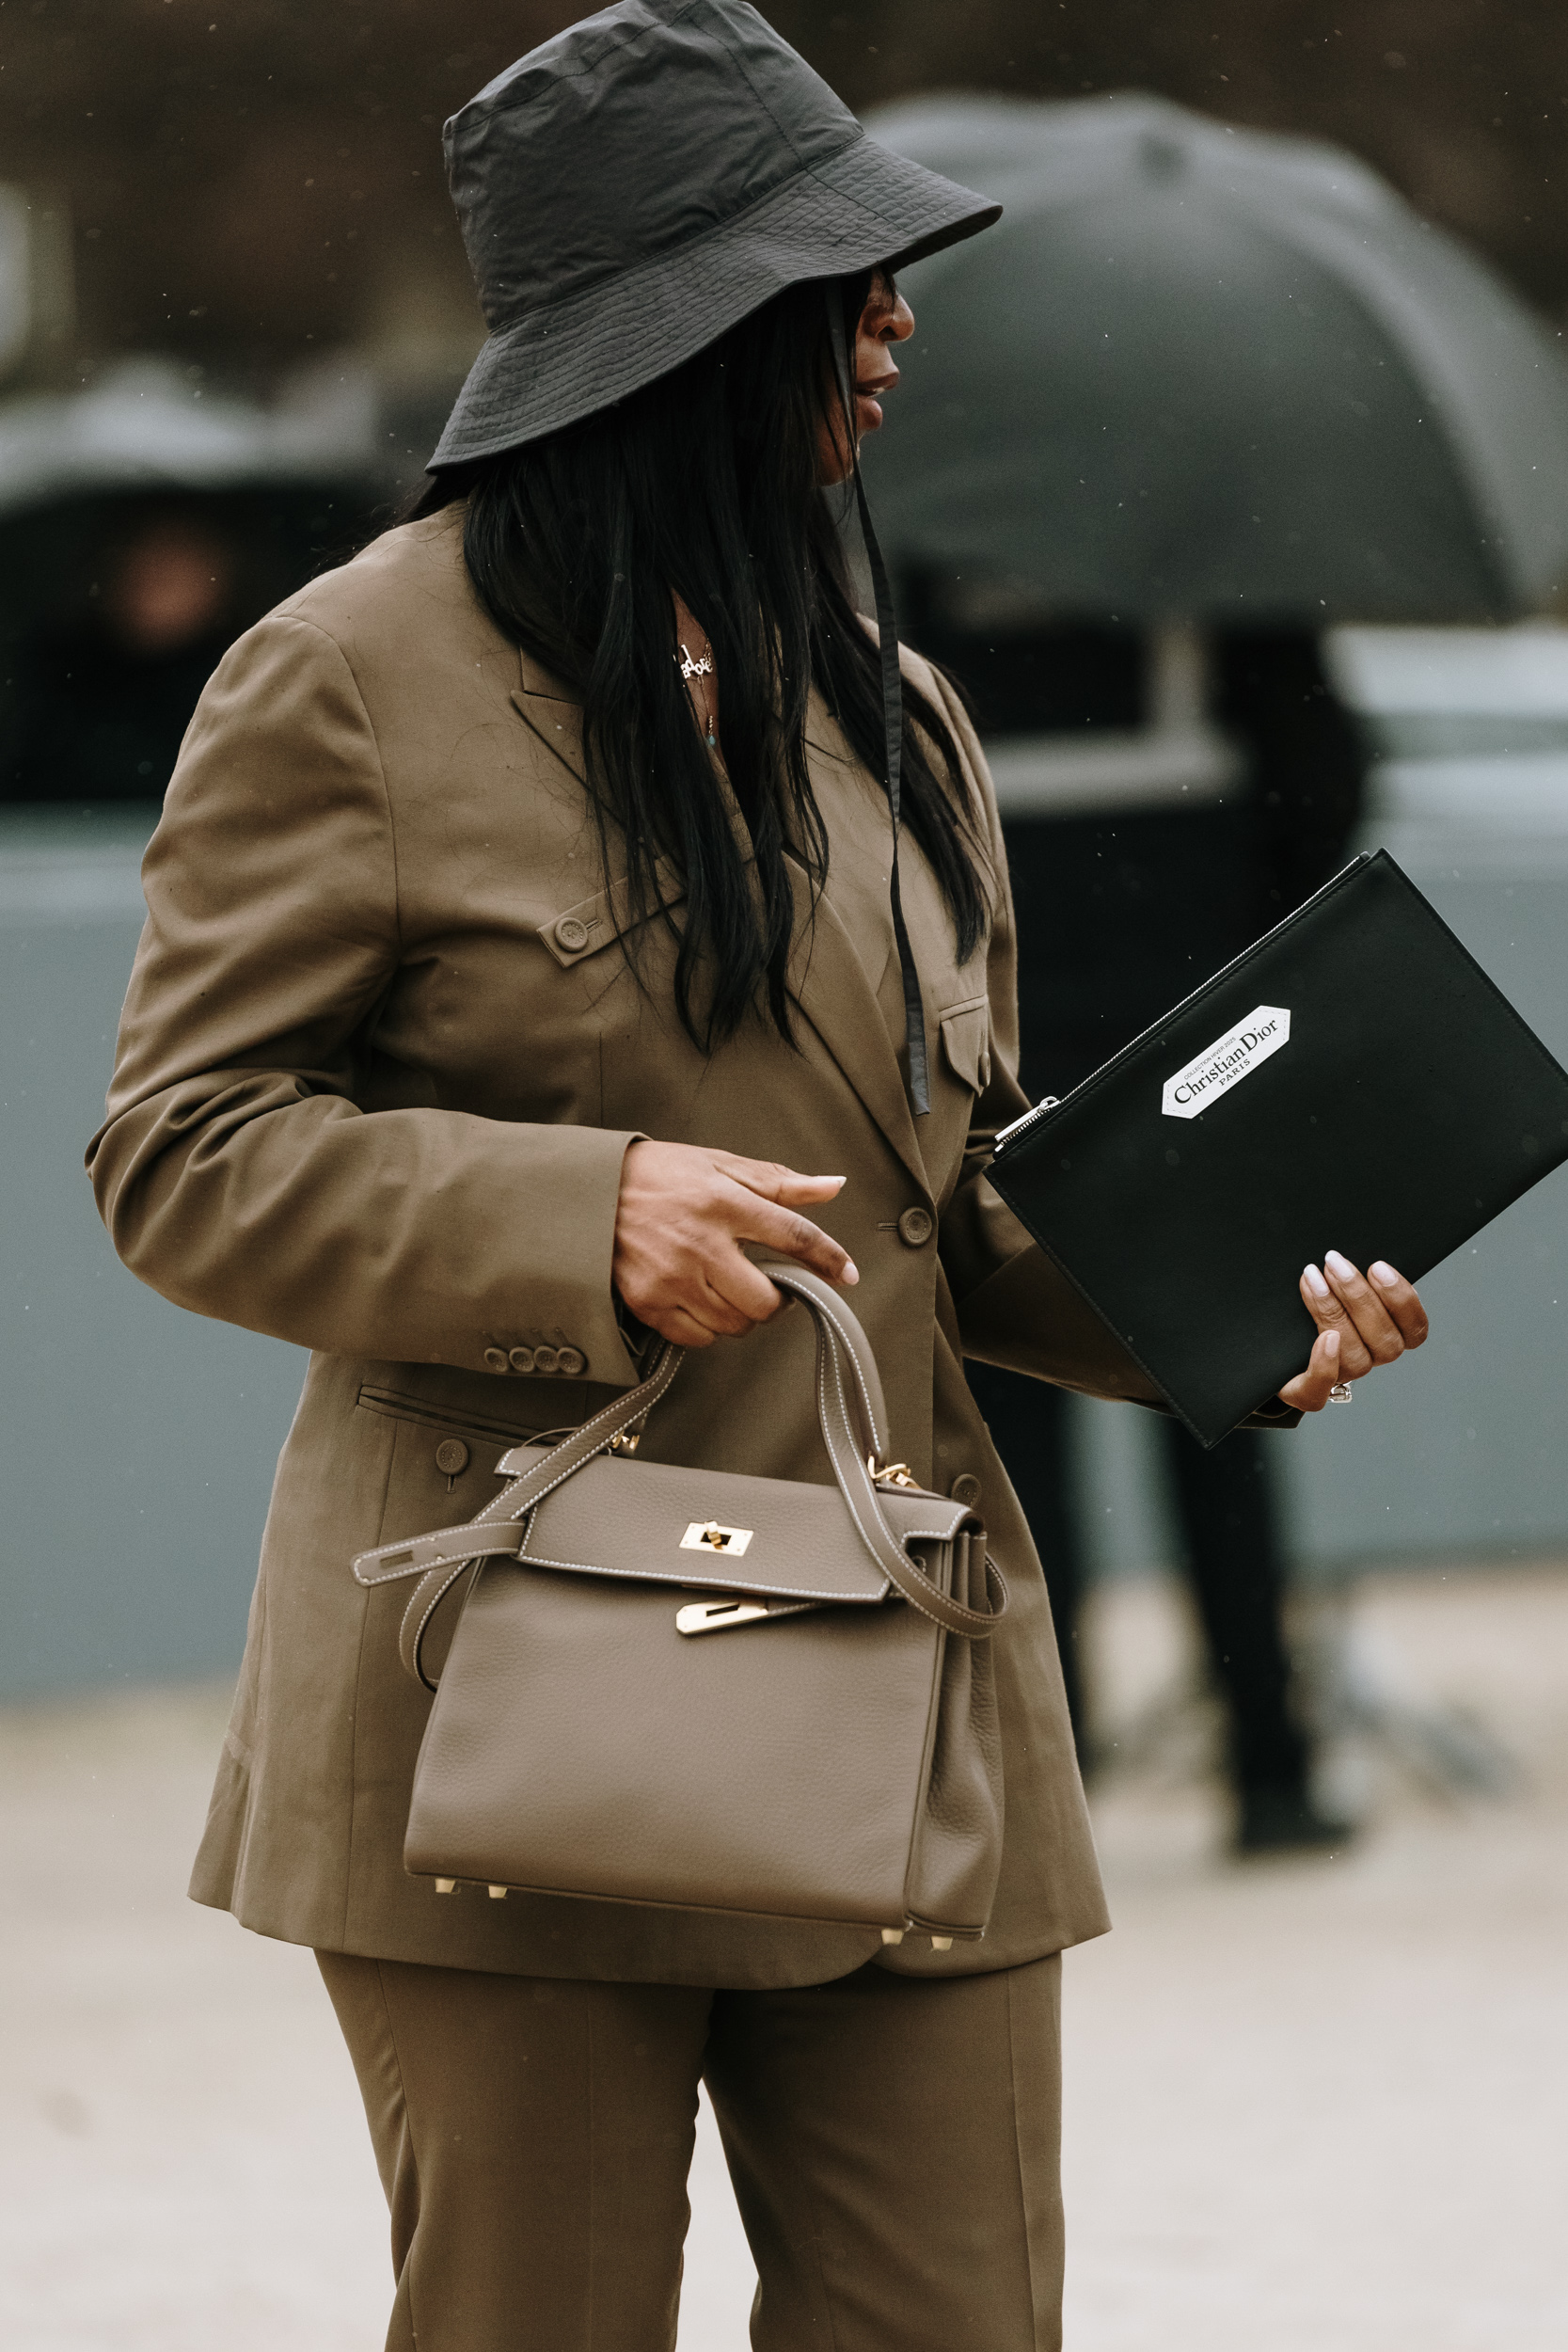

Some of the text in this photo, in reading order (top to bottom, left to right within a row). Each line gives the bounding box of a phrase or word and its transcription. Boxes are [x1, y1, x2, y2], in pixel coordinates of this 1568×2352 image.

[1174, 1019, 1278, 1104] Christian Dior
[1183, 1036, 1236, 1080] COLLECTION HIVER 2025
[1218, 1057, 1251, 1087] PARIS
